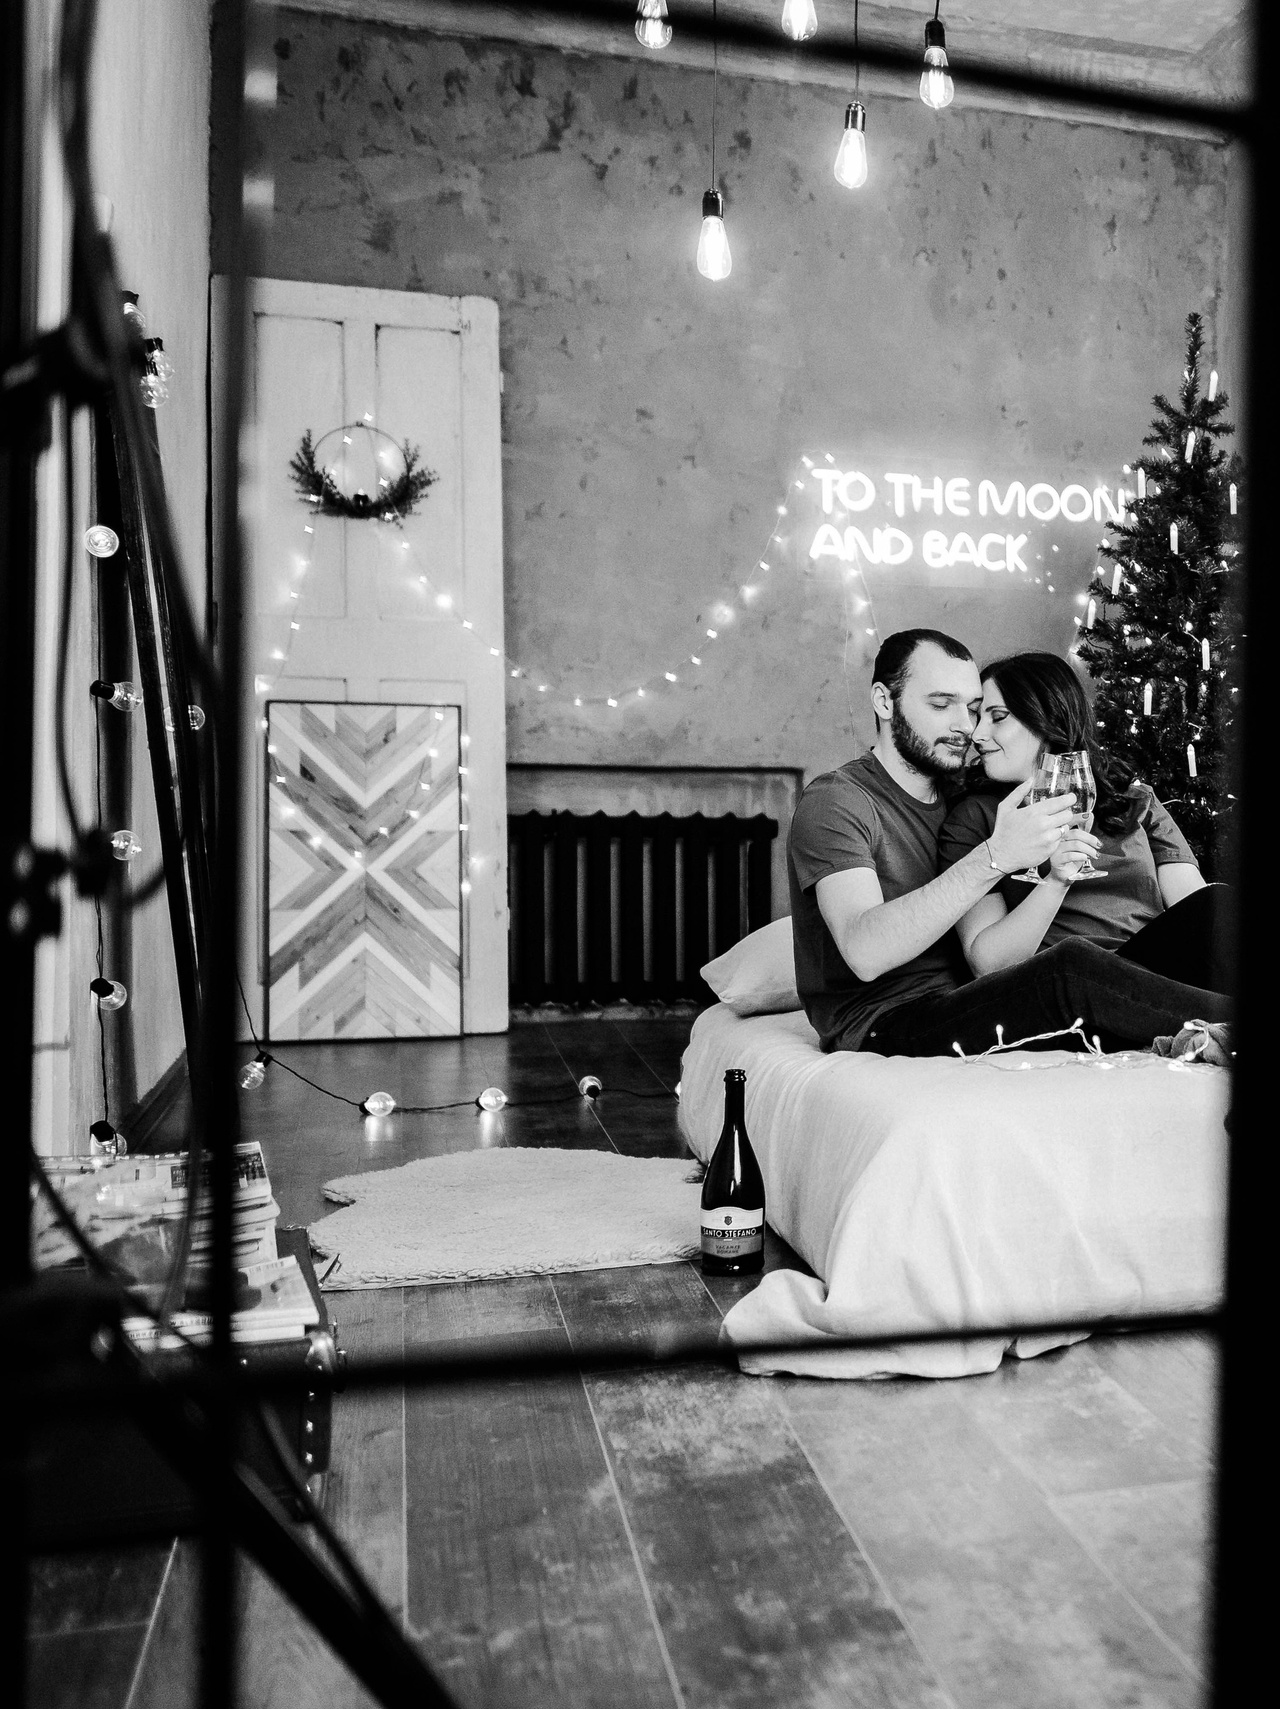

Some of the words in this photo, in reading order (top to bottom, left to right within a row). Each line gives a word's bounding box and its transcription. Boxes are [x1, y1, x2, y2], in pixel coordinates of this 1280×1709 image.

[811, 469, 876, 514] TO
[884, 472, 970, 517] THE
[978, 479, 1126, 523] MOON
[809, 524, 914, 565] AND
[922, 530, 1028, 572] BACK
[703, 1228, 722, 1237] SANTO
[724, 1228, 756, 1237] STEFANO
